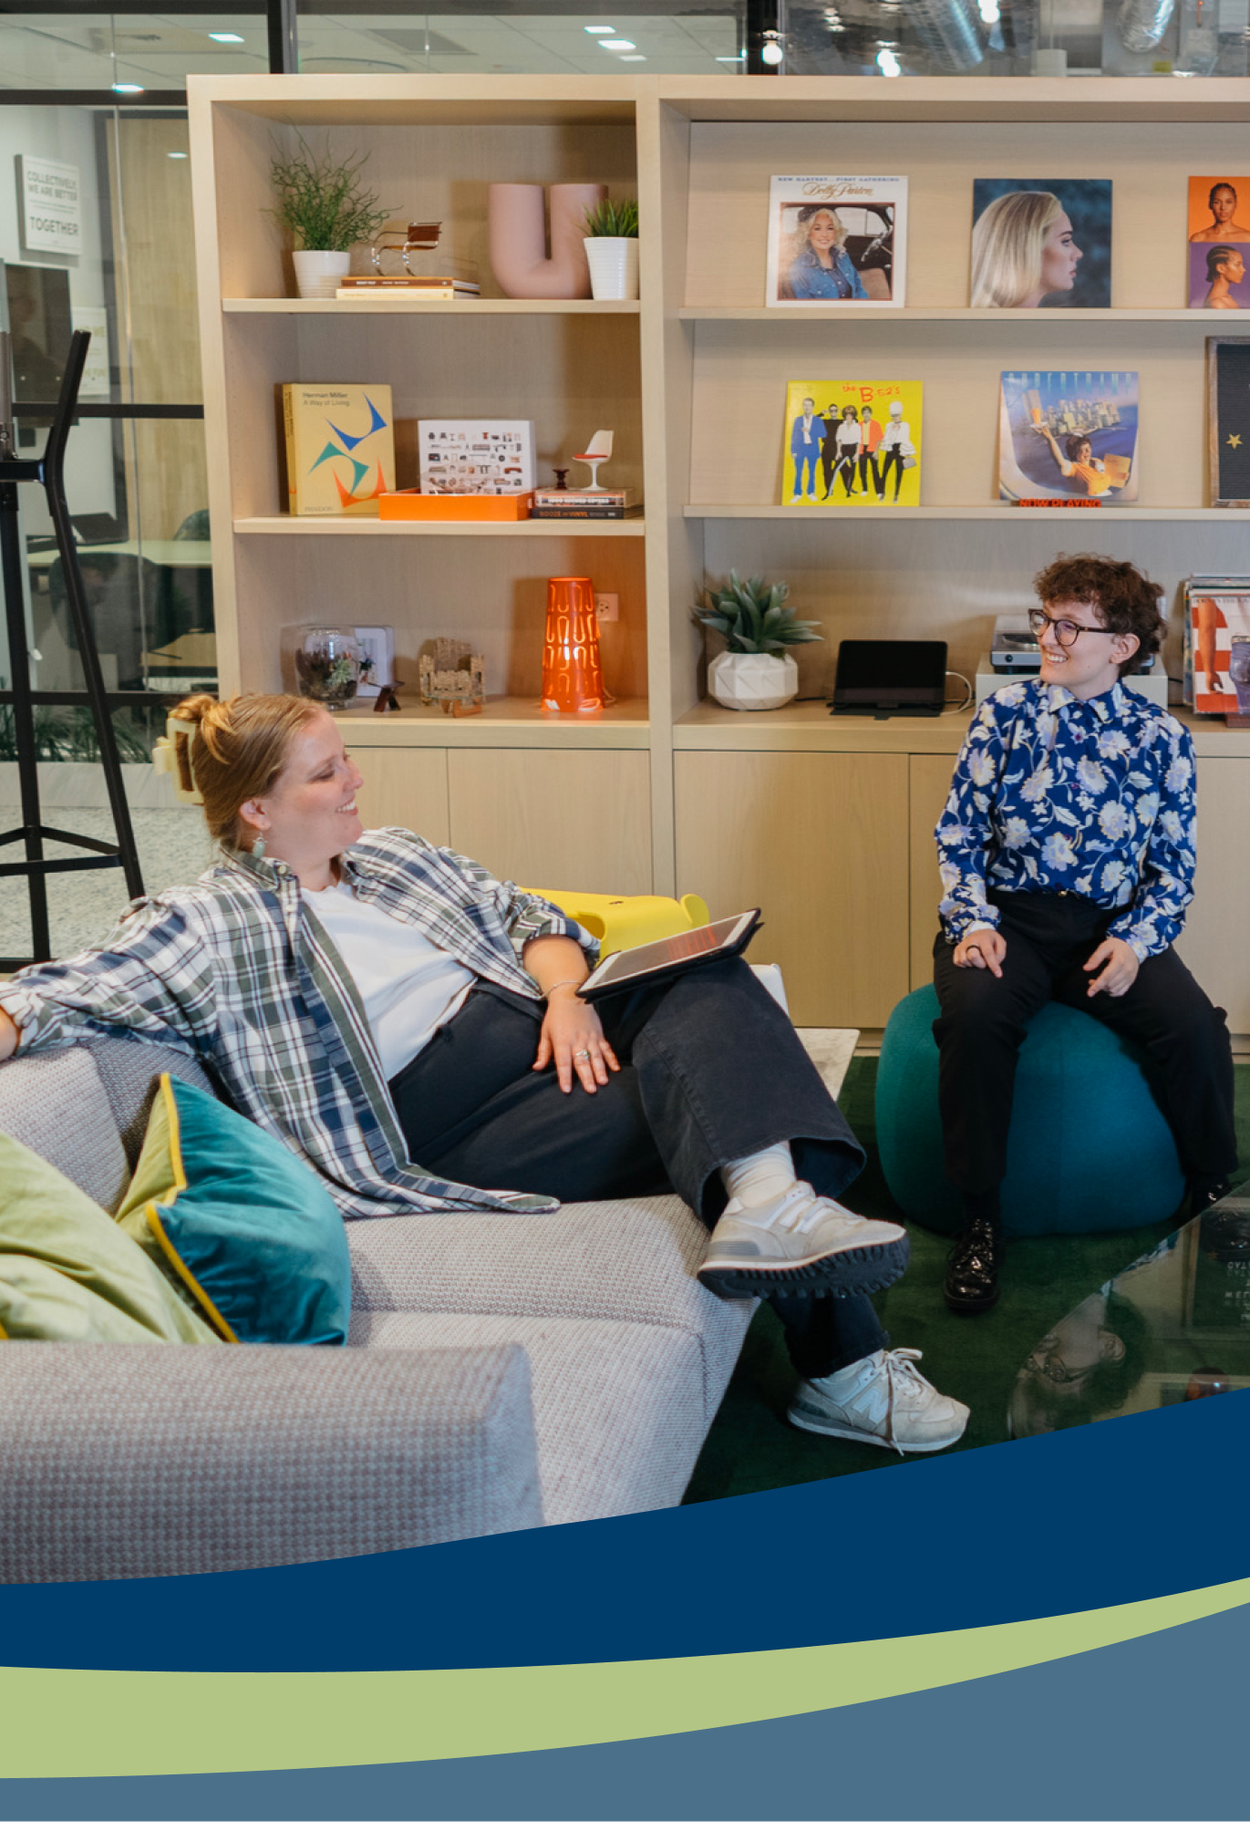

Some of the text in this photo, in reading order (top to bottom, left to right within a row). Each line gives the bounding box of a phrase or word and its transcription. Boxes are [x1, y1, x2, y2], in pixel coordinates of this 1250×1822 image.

[54, 188, 78, 202] BETTER
[801, 181, 874, 201] Dolly Parton
[29, 216, 80, 236] TOGETHER
[842, 382, 857, 393] the
[1019, 499, 1102, 508] NOW PLAYING
[568, 510, 589, 518] VINYL
